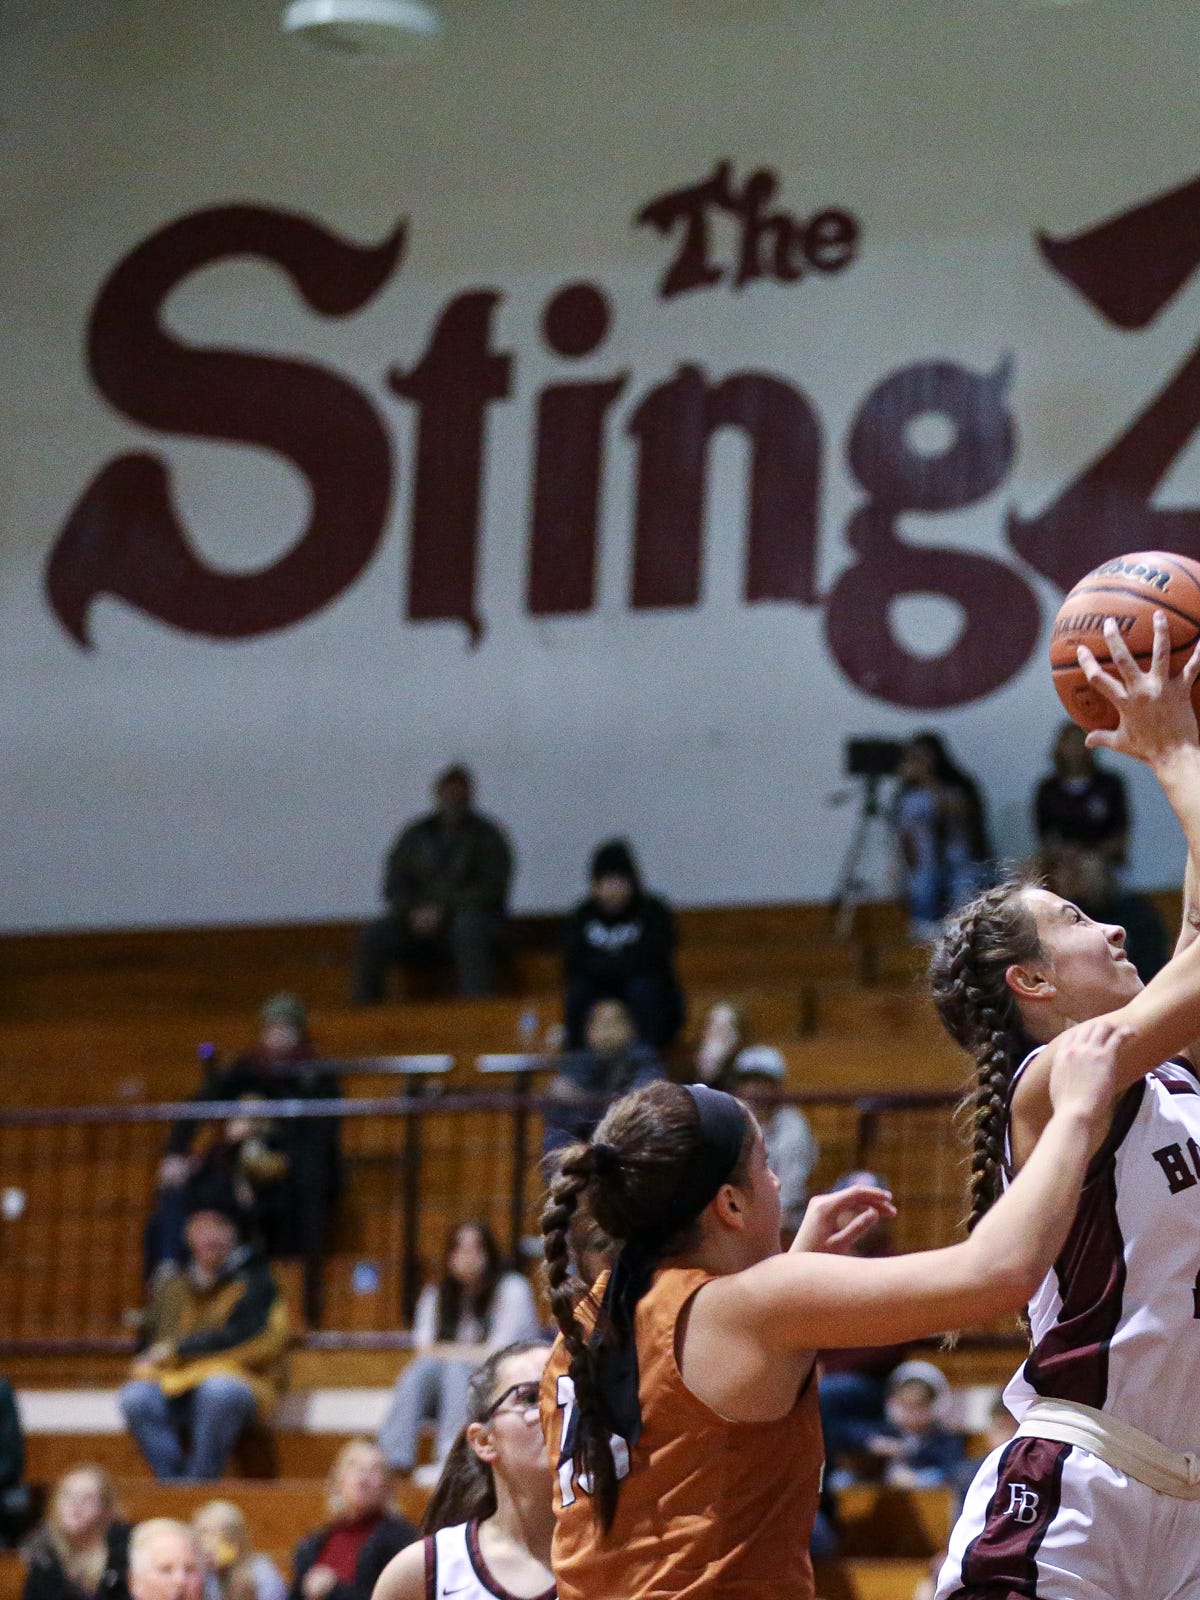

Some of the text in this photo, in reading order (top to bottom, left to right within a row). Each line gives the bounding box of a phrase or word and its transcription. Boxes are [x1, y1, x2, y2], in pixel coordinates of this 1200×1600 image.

[636, 158, 860, 299] The
[44, 202, 1044, 712] Sting
[1003, 1482, 1039, 1524] FB
